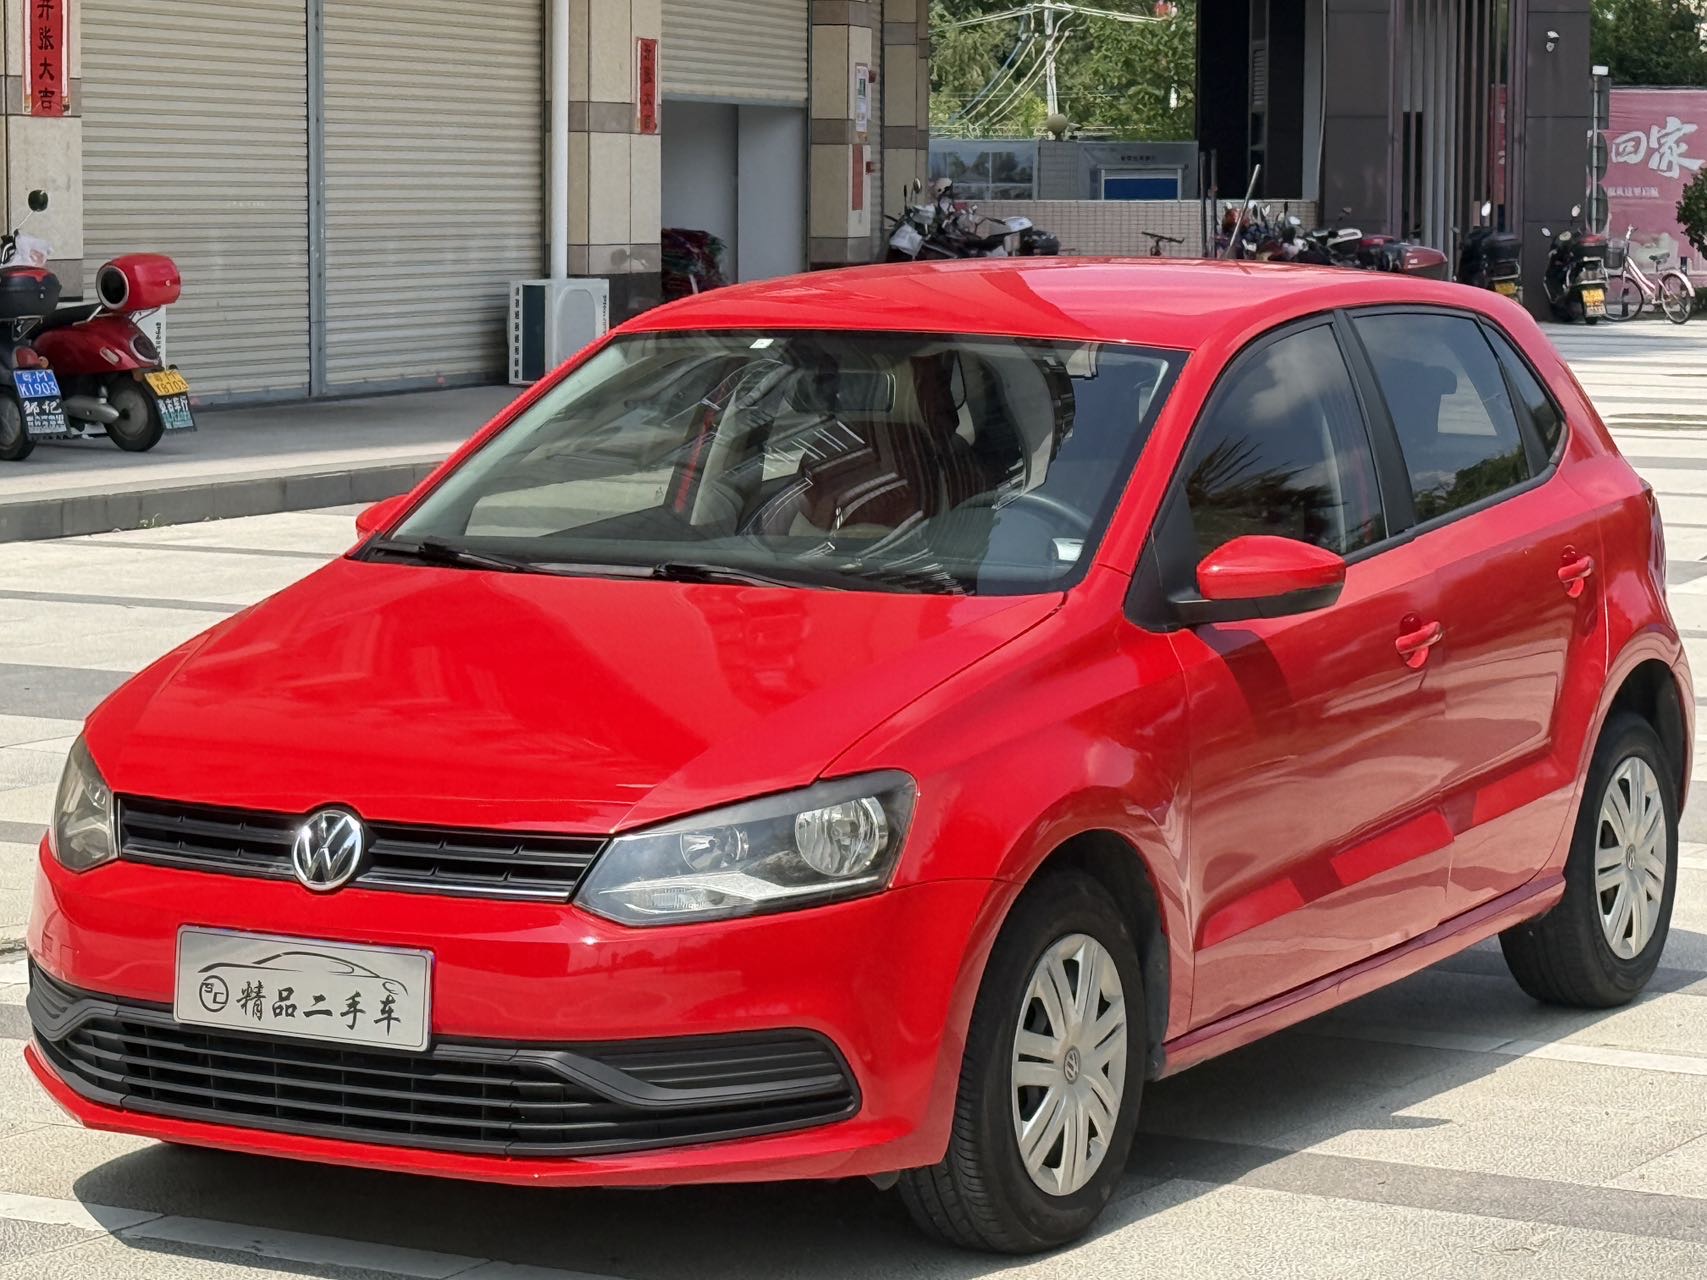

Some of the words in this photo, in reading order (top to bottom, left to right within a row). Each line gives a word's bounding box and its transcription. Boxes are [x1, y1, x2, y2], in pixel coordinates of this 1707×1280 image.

[1611, 117, 1706, 179] 回家
[19, 381, 57, 396] K1903
[236, 980, 402, 1037] 精品二手车
